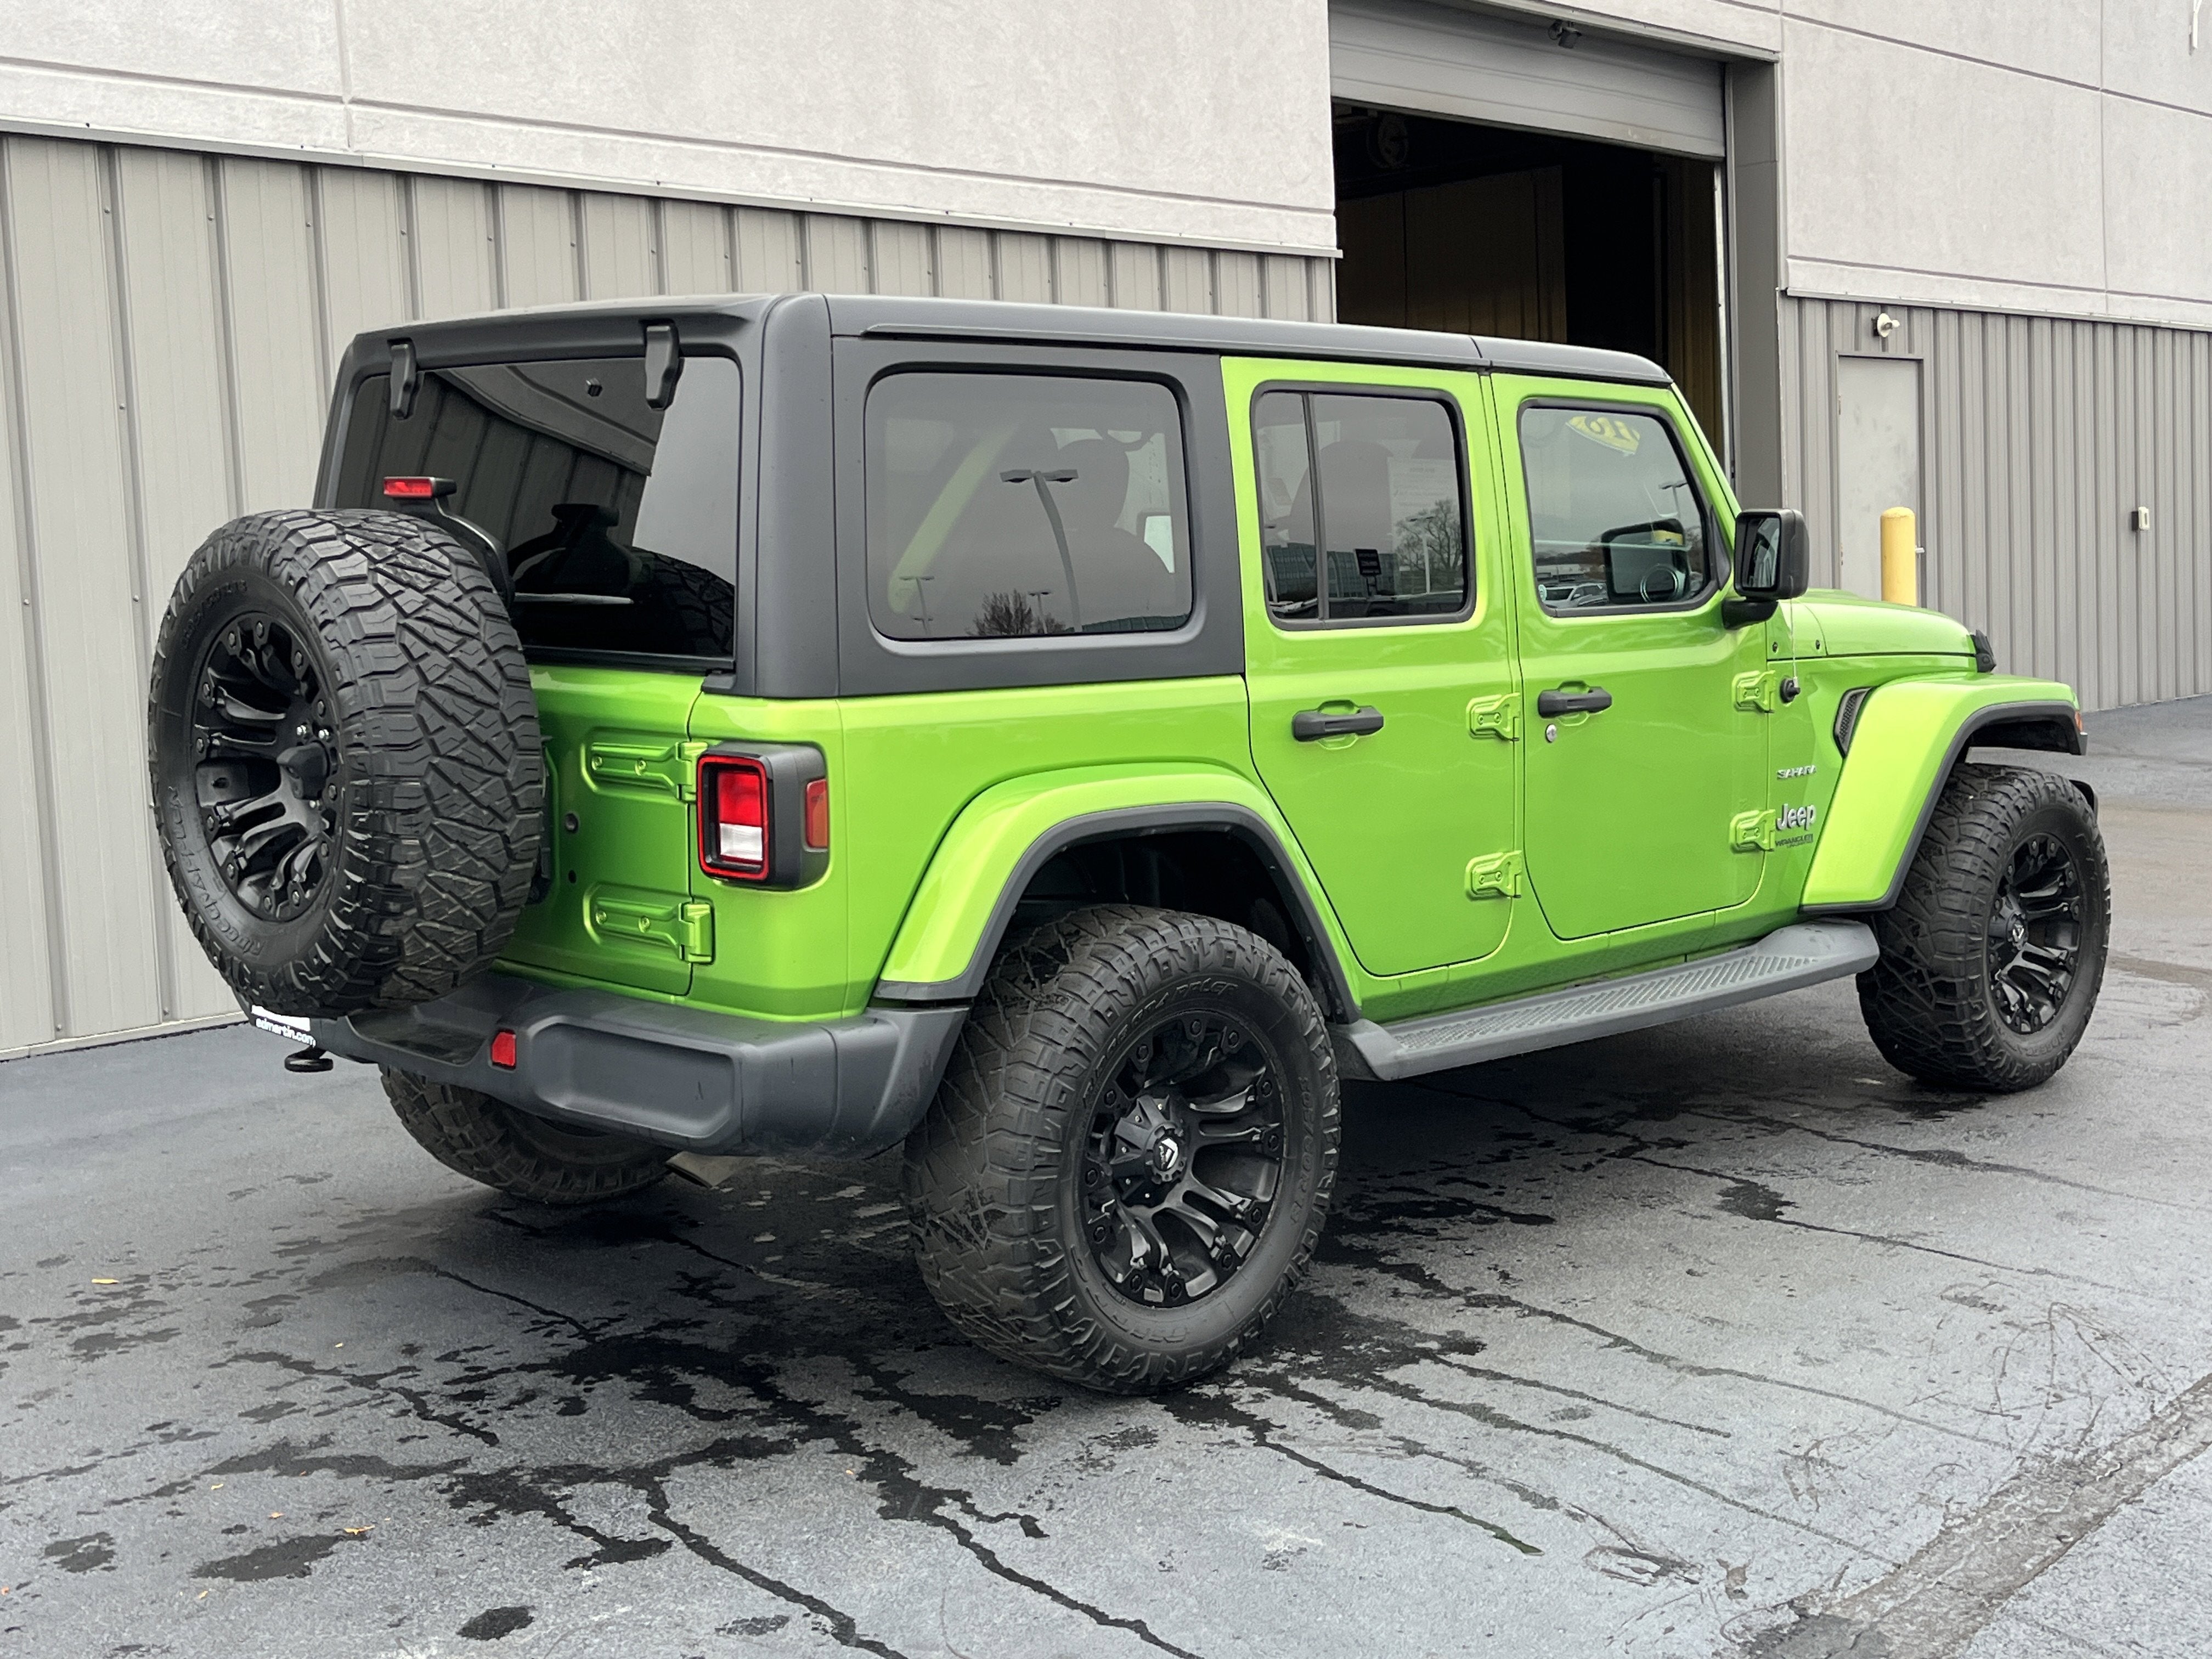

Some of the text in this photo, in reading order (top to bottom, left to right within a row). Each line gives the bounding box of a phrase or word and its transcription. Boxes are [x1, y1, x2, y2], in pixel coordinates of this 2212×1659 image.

[1777, 765, 1816, 780] SAHARA
[1776, 803, 1816, 831] Jeep
[256, 1018, 317, 1048] edmartin.com
